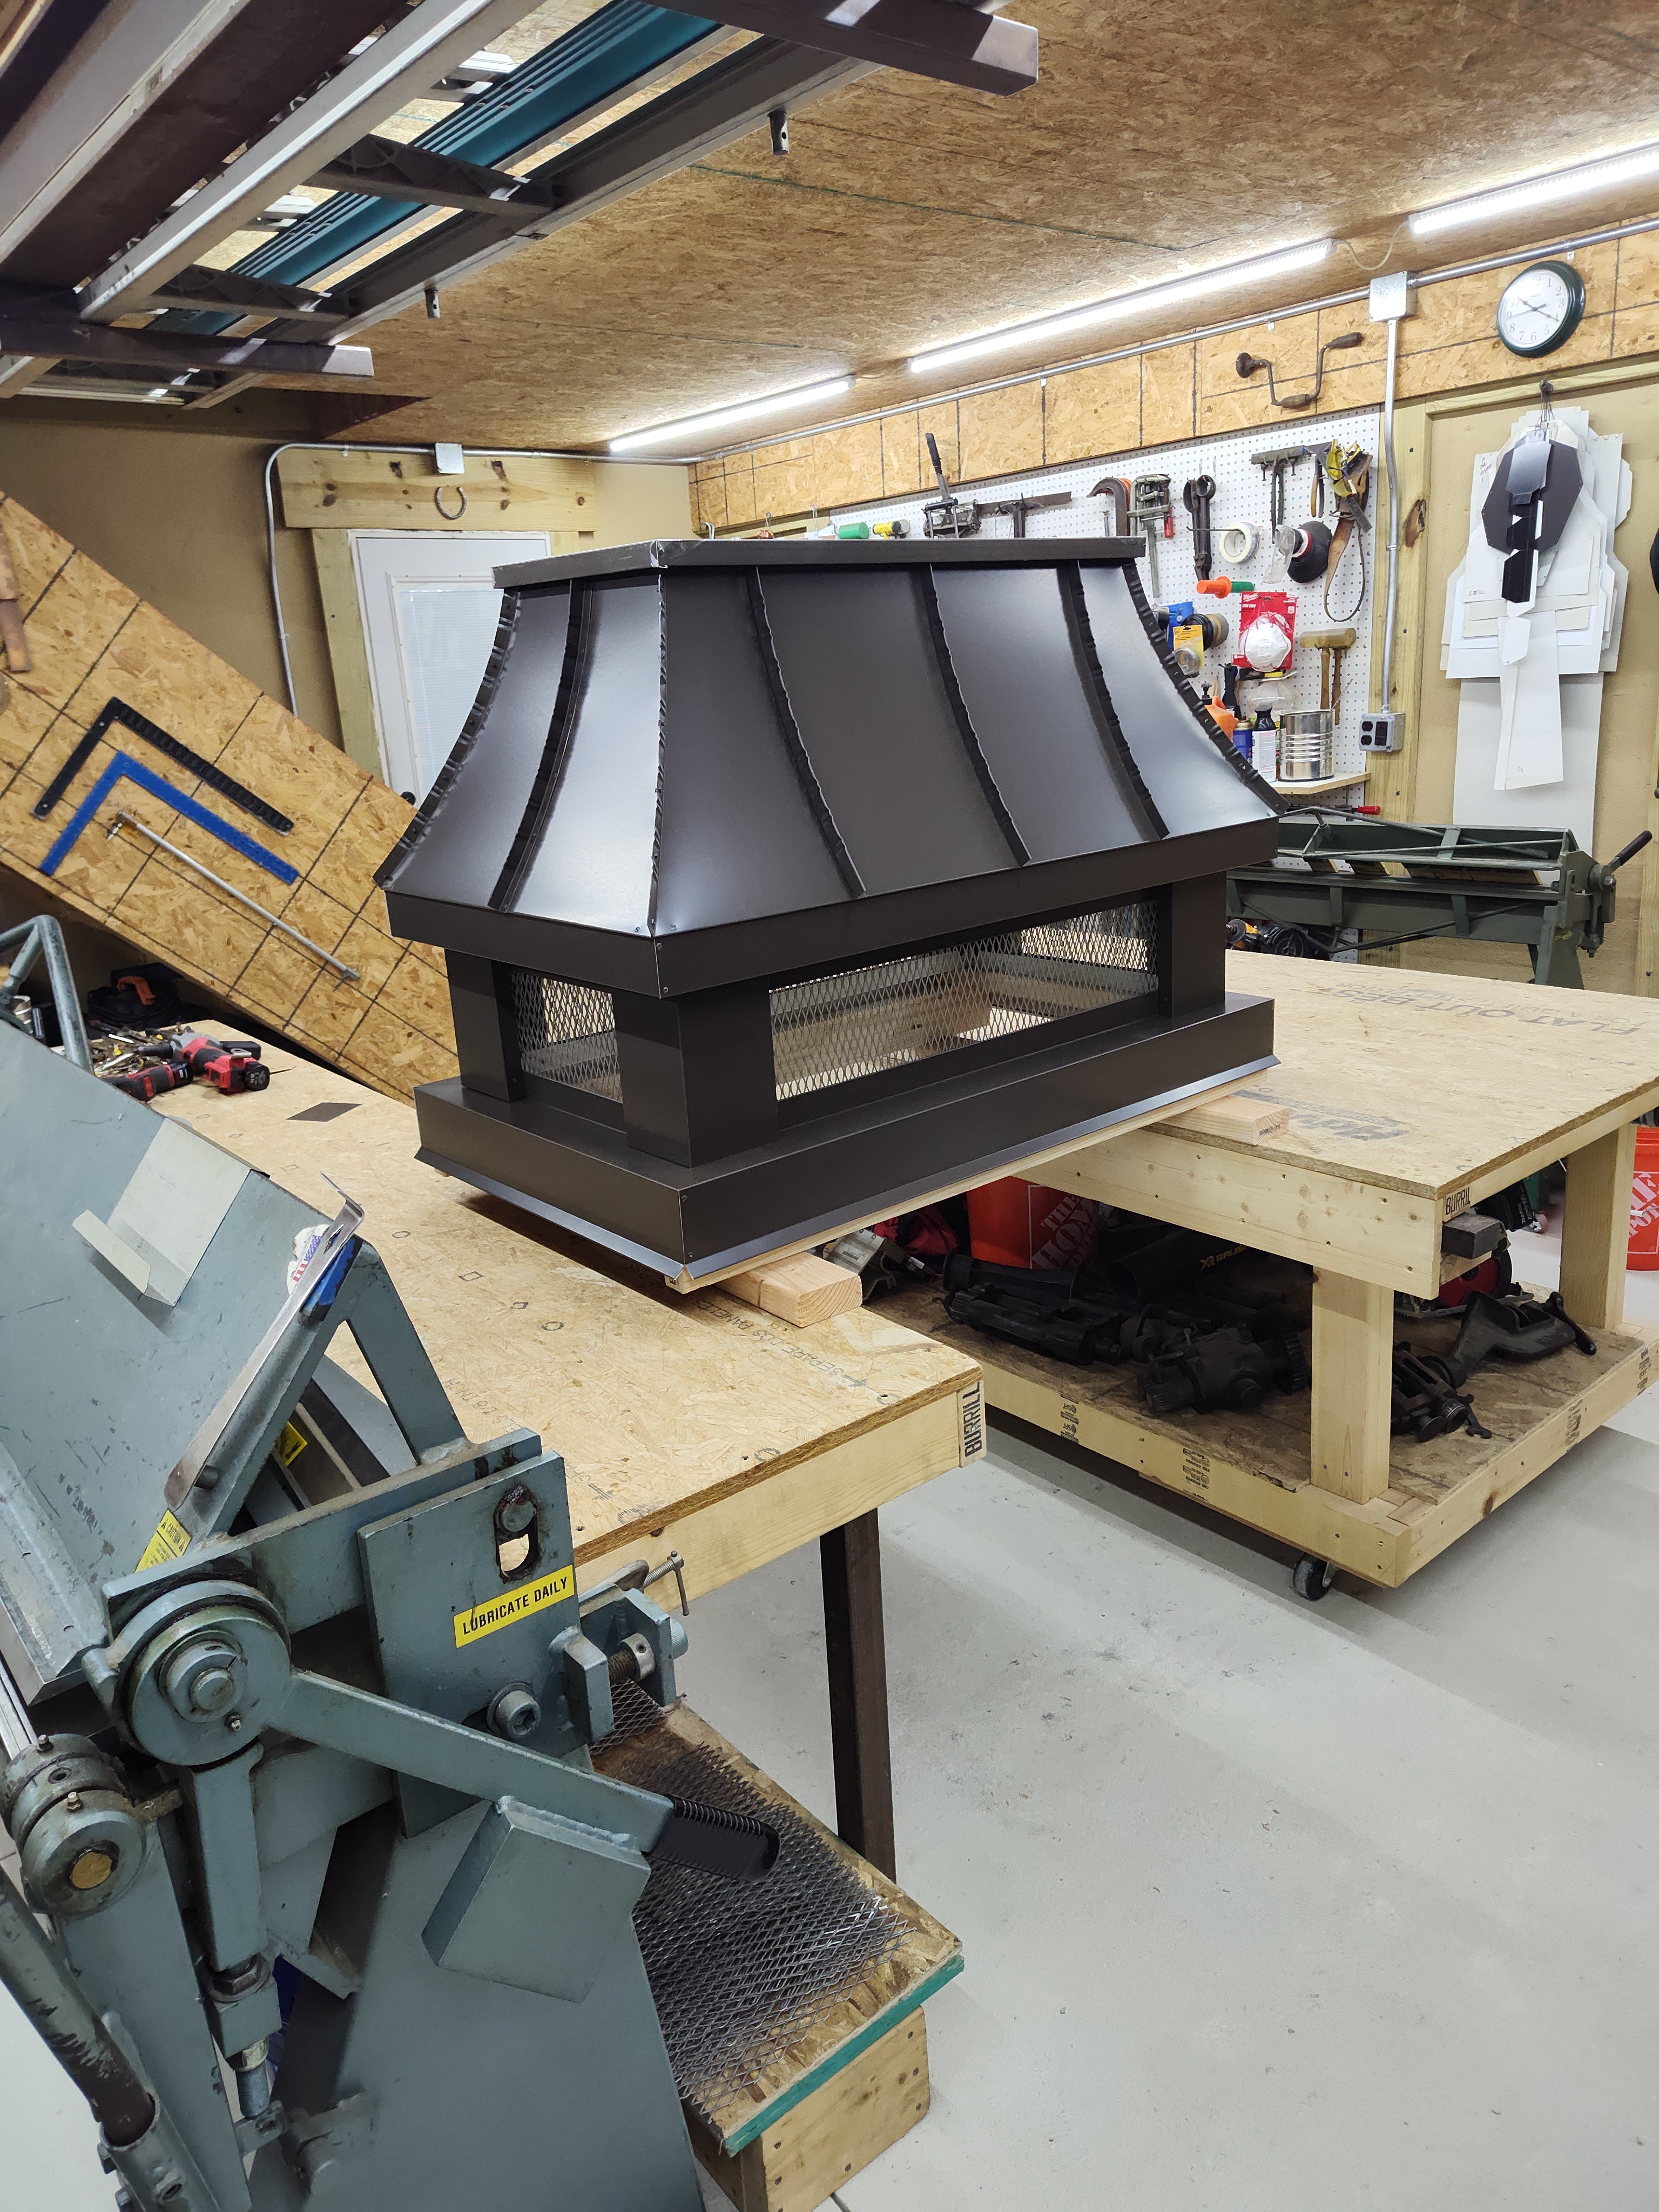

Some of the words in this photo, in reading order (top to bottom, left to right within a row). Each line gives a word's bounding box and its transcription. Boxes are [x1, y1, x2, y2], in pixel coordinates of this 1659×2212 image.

[1547, 278, 1552, 288] 1
[1555, 286, 1562, 296] 2
[1558, 298, 1565, 309] 3
[1506, 310, 1513, 321] 9
[1509, 322, 1515, 333] 8
[1543, 325, 1549, 335] 5
[1519, 331, 1525, 341] 7
[1530, 331, 1537, 342] 6
[1305, 988, 1417, 1005] BEST
[1416, 1001, 1516, 1018] OUT
[1518, 1015, 1641, 1035] FLAT
[1040, 1193, 1080, 1232] THE
[694, 1299, 754, 1330] PANELES
[752, 1330, 784, 1346] LOS
[962, 1381, 982, 1458] BURRILL
[165, 1522, 182, 1546] CAUTION
[463, 1594, 530, 1635] LUBRICATE
[534, 1576, 568, 1603] DAILY
